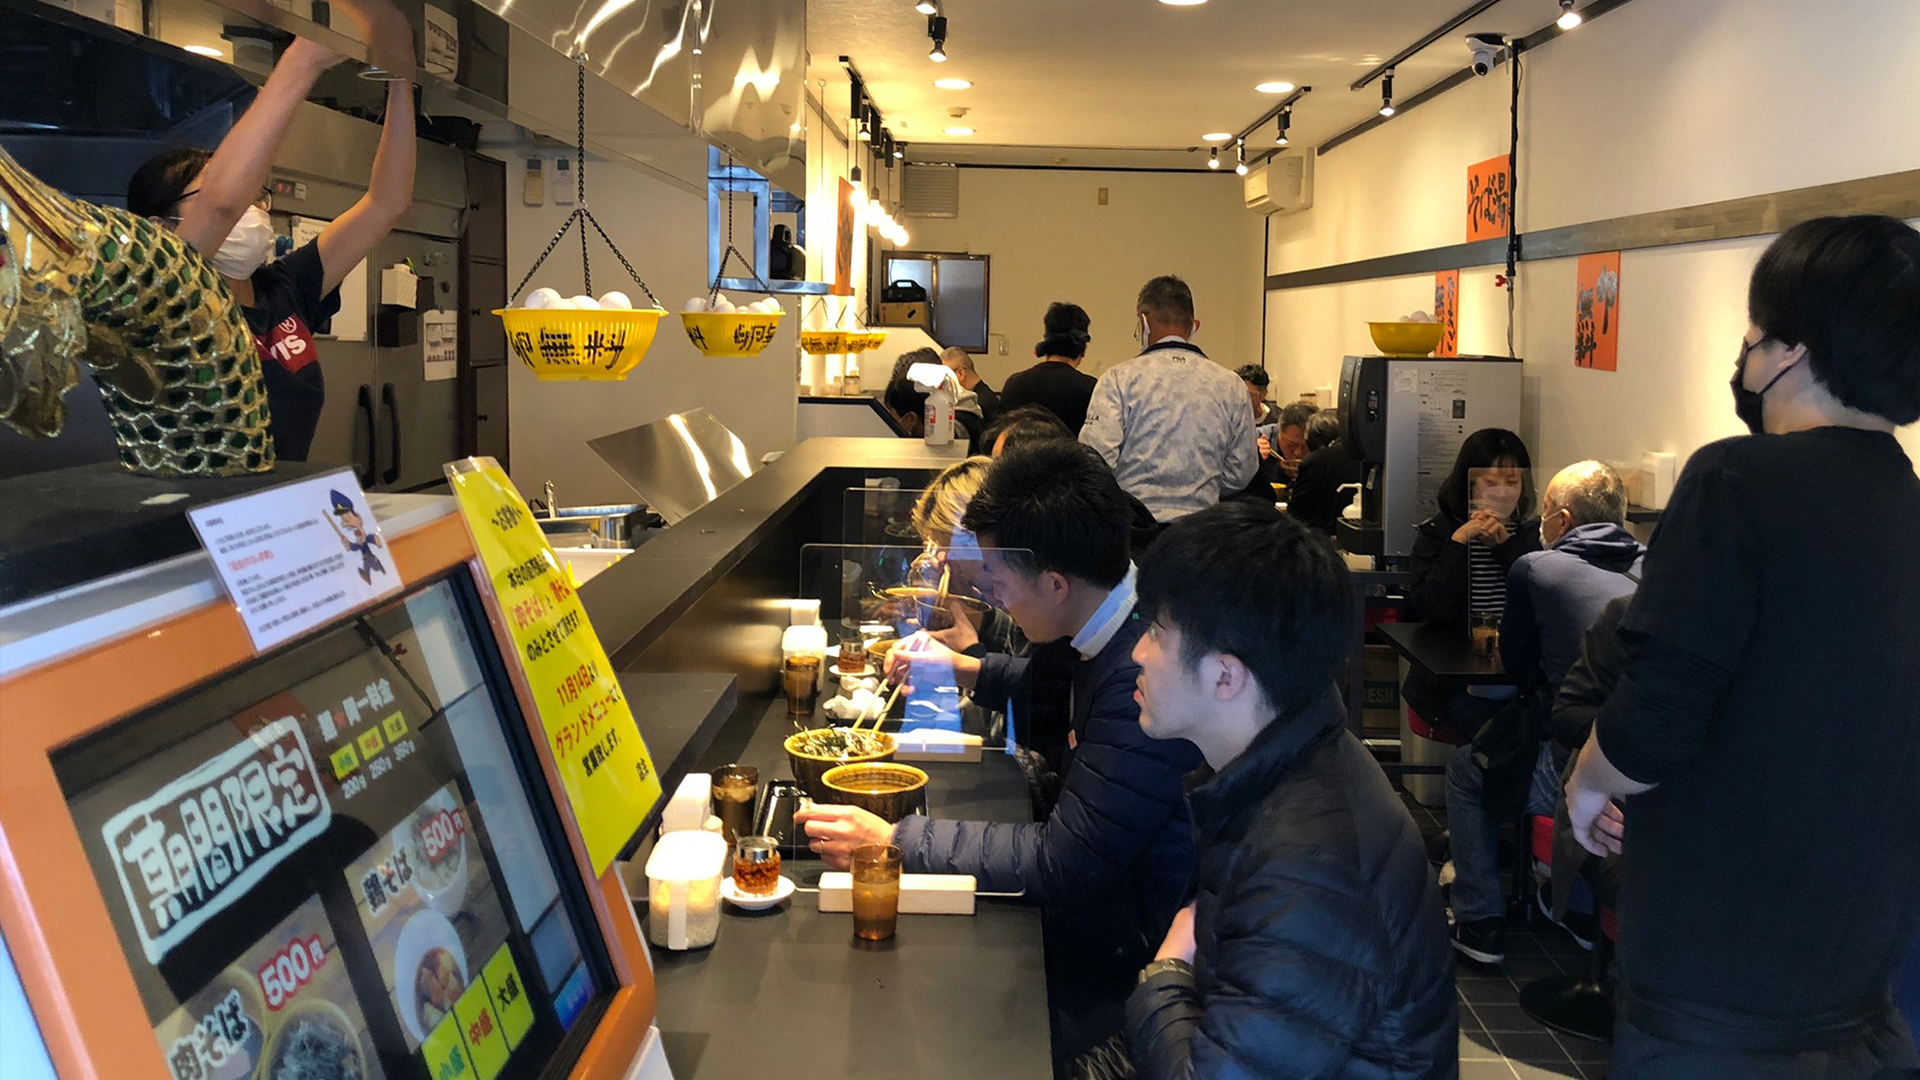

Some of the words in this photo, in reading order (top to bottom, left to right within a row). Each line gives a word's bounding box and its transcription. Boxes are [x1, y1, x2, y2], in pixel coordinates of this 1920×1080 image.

[557, 660, 599, 707] 11月14日より
[122, 743, 318, 930] 期間限定
[260, 938, 324, 1007] 500円
